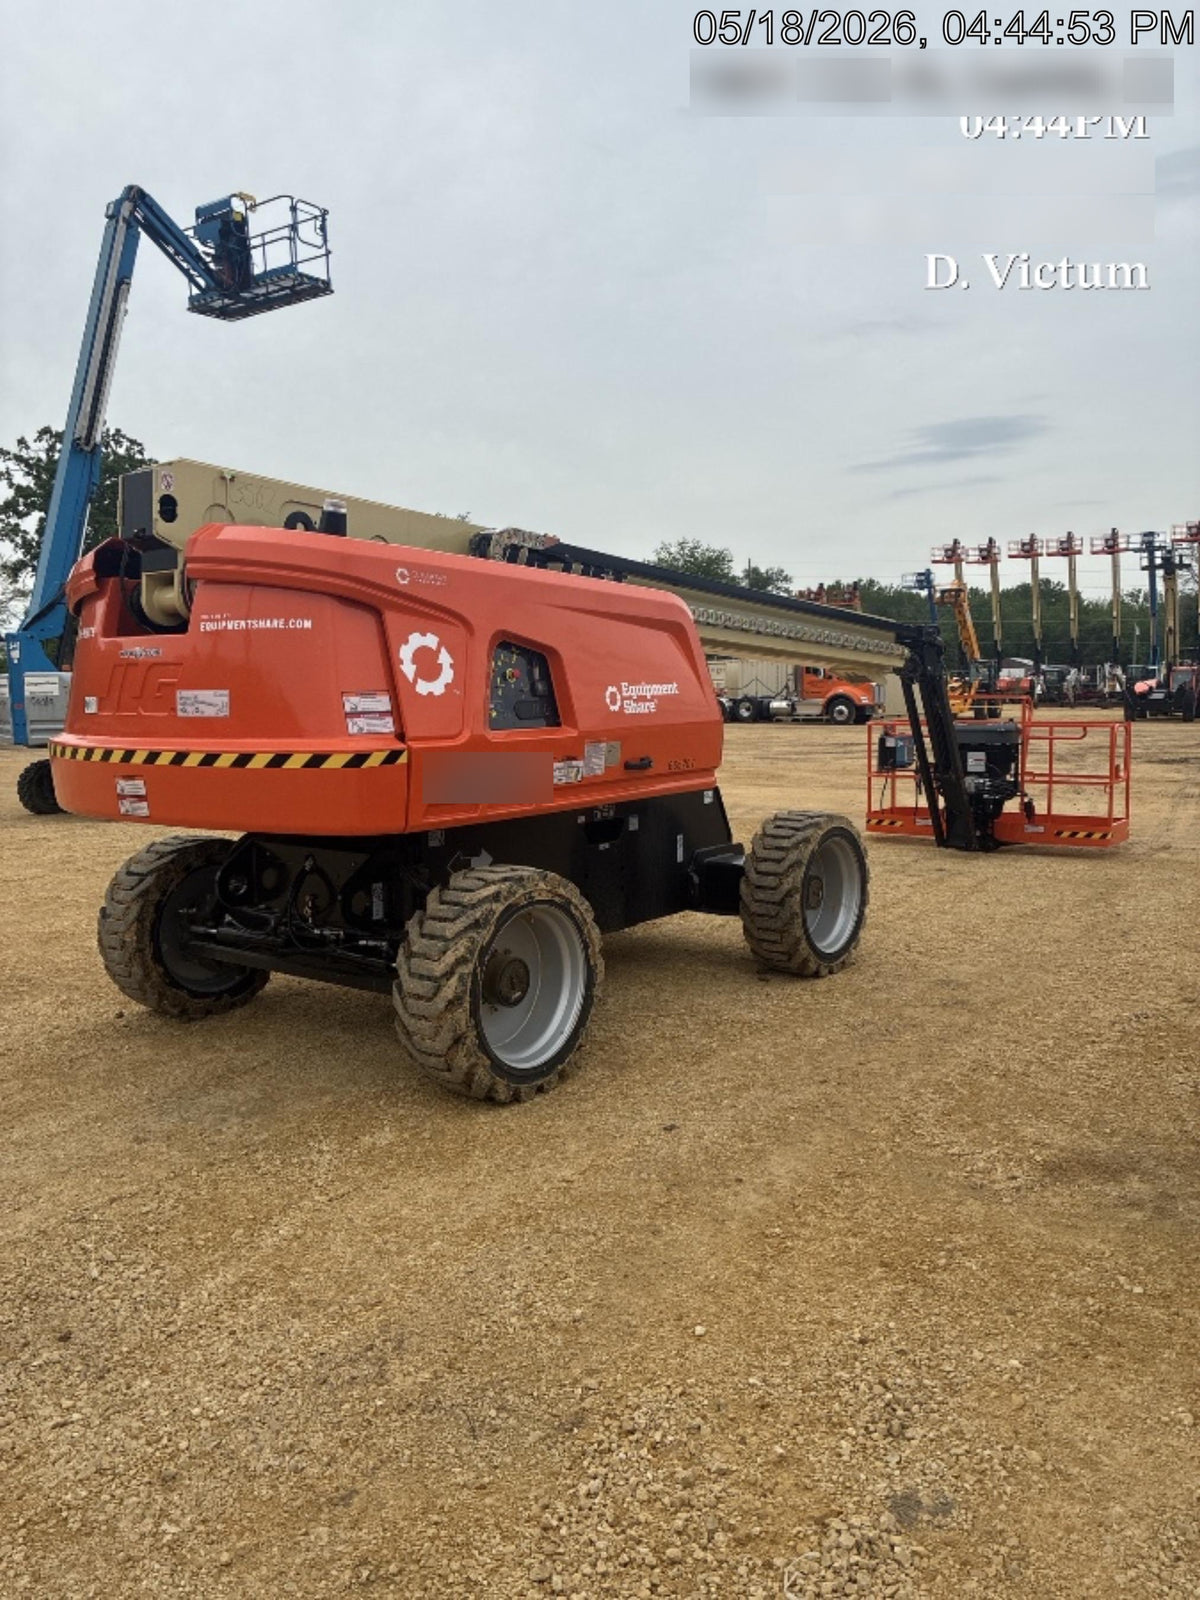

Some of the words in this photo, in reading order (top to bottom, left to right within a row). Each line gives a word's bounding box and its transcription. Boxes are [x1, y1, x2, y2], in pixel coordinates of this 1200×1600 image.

[199, 619, 312, 632] EQUIPMENTSHARE.COM
[620, 682, 680, 699] Equipment
[623, 699, 656, 714] Share
